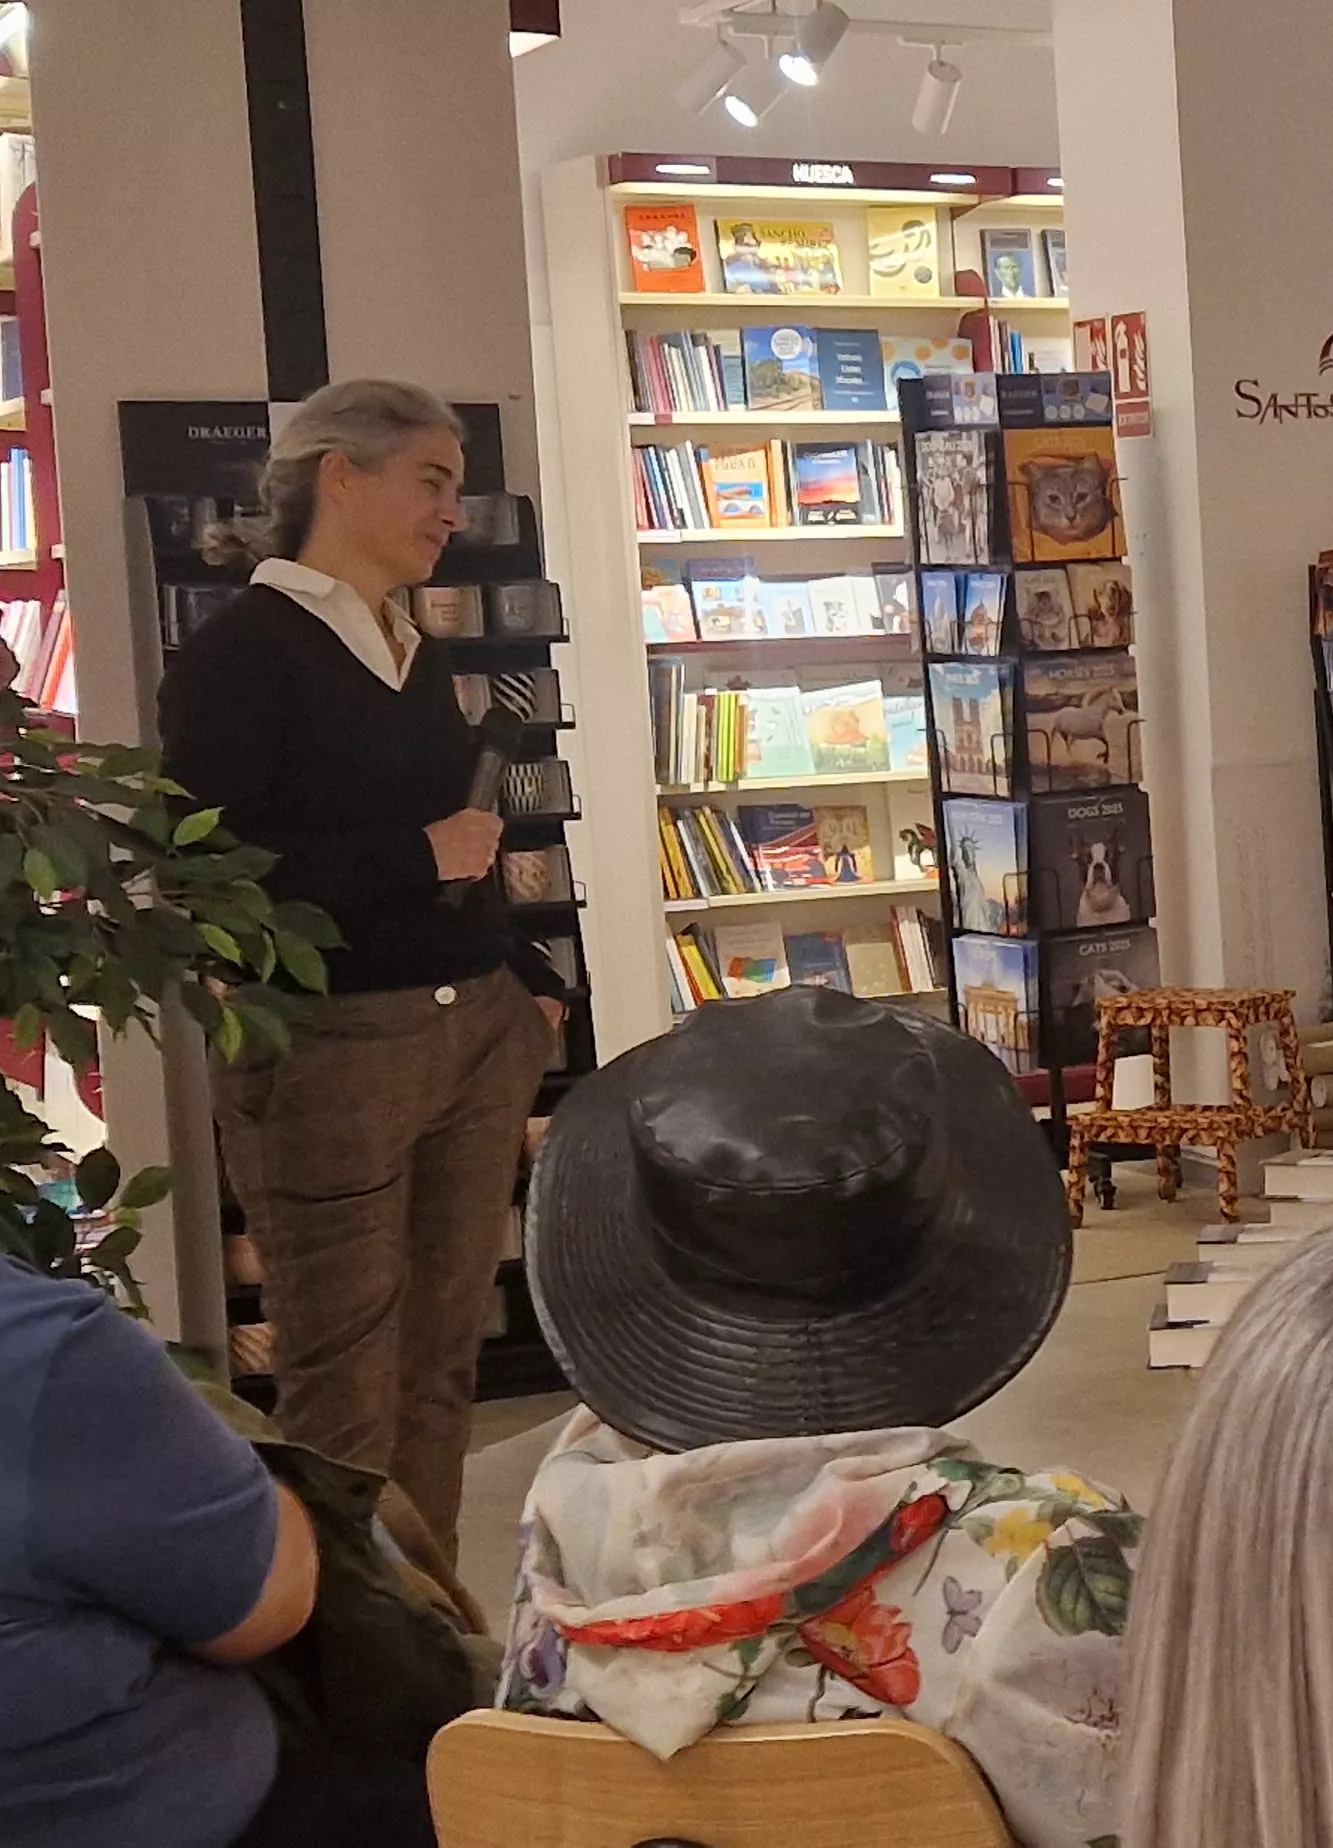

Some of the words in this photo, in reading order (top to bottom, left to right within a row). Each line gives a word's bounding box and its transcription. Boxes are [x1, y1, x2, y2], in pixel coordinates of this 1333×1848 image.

[792, 162, 854, 183] HUESCA
[1068, 806, 1100, 819] DOGS
[1079, 942, 1107, 956] CATS
